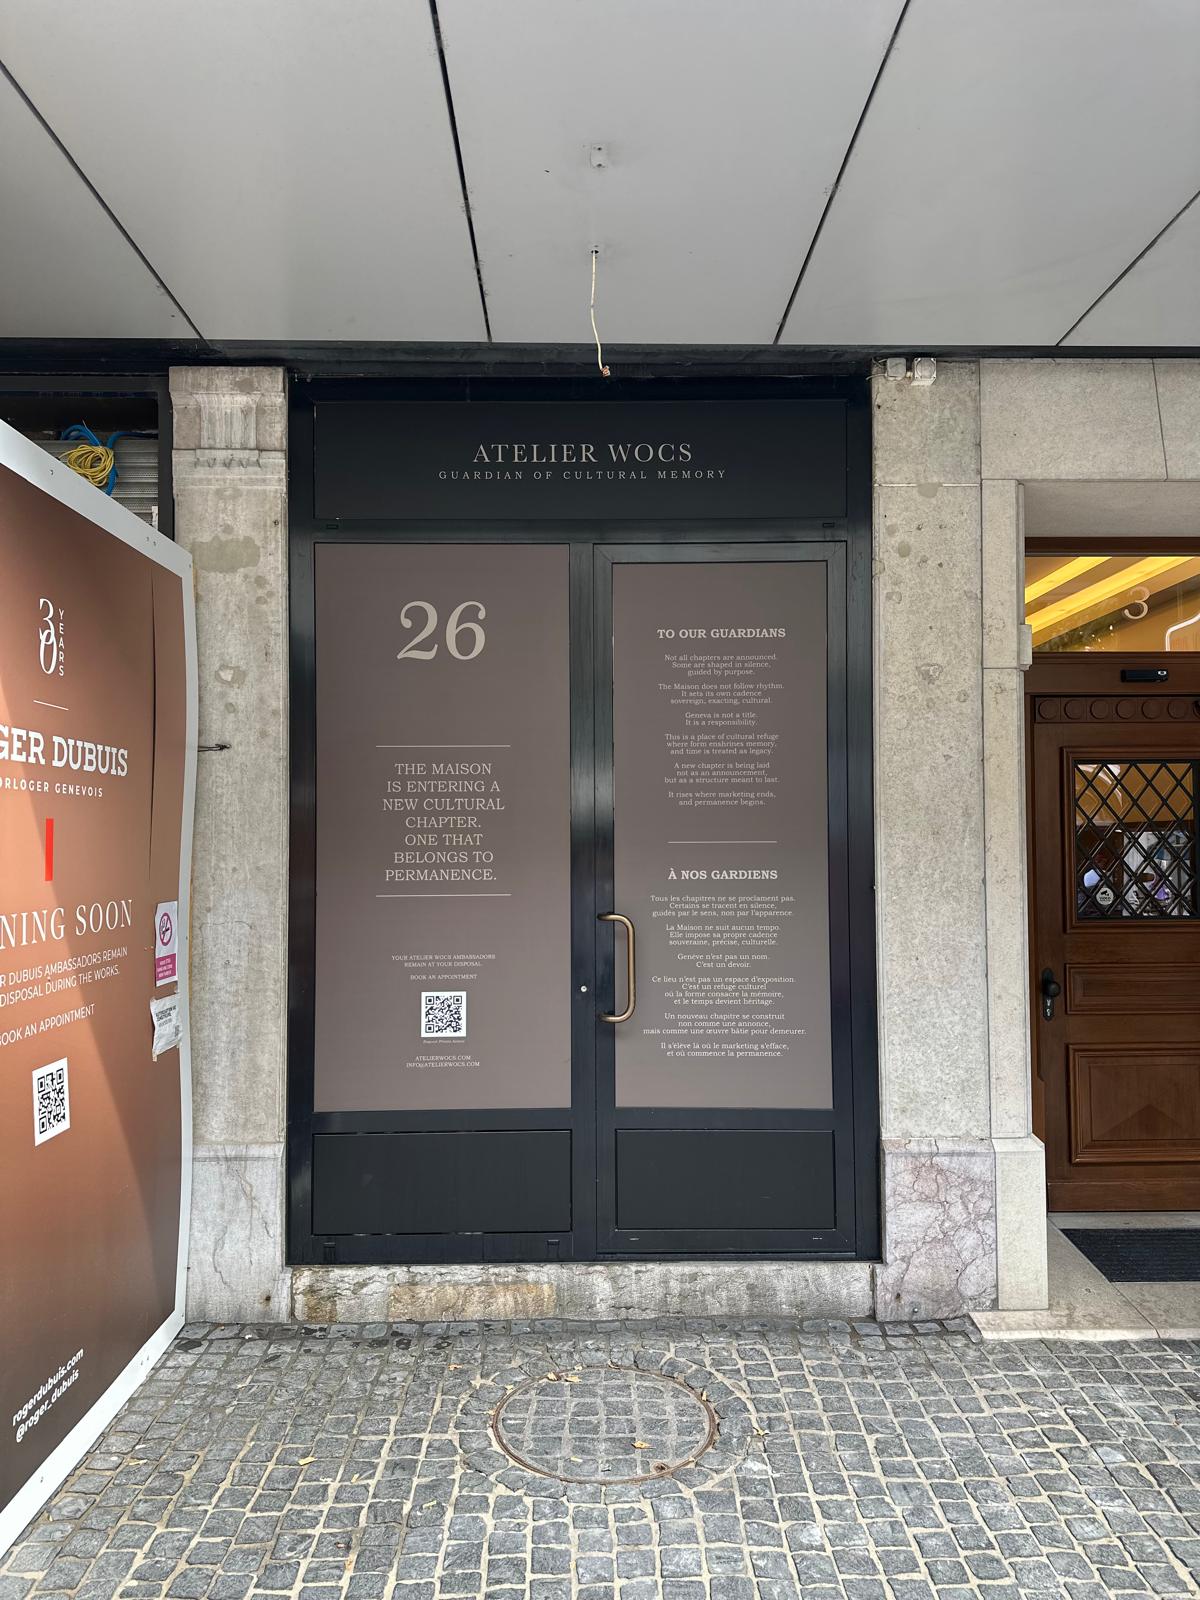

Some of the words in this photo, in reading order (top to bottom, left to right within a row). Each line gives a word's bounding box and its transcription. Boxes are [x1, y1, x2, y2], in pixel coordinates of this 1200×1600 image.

[474, 444, 598, 462] ATELIER
[608, 443, 692, 462] WOCS
[438, 471, 524, 479] GUARDIAN
[534, 471, 552, 479] OF
[563, 470, 646, 479] CULTURAL
[657, 470, 724, 478] MEMORY
[1124, 586, 1150, 620] 3
[397, 600, 486, 660] 26
[656, 629, 675, 638] TO
[678, 628, 706, 638] OUR
[710, 628, 786, 638] GUARDIANS
[690, 654, 720, 662] chapters
[707, 661, 732, 669] shaped
[687, 668, 711, 677] guided
[713, 668, 722, 677] by
[697, 733, 715, 742] place
[757, 733, 778, 741] refuge
[52, 735, 128, 777] DUBUIS
[394, 763, 426, 774] THE
[431, 763, 491, 774] MAISON
[55, 783, 102, 798] GENEVOIS
[387, 780, 401, 792] IS
[407, 780, 485, 792] ENTERING
[490, 780, 500, 791] A
[718, 791, 755, 799] marketing
[383, 798, 418, 810] NEW
[423, 798, 504, 810] CULTURAL
[405, 816, 482, 827] CHAPTER.
[404, 834, 437, 845] ONE
[442, 833, 483, 845] THAT
[394, 851, 468, 863] BELONGS
[472, 851, 493, 862] TO
[386, 868, 497, 880] PERMANENCE.
[668, 867, 677, 879] À
[680, 870, 707, 879] NOS
[710, 870, 778, 879] GARDIENS
[76, 900, 132, 936] SOON
[8, 966, 42, 986] DUBUIS
[44, 952, 101, 976] AMBASSADORS
[102, 946, 128, 962] REMAIN
[46, 976, 76, 995] DURING
[78, 971, 92, 985] THE
[94, 964, 120, 980] WORKS.
[714, 983, 736, 991] refuge
[710, 1013, 740, 1021] chapitre
[0, 1028, 22, 1046] OOK
[24, 1022, 37, 1038] AN
[39, 1004, 95, 1032] APPOINTMENT
[12, 1348, 84, 1426] rogerdubuis.com
[16, 1369, 79, 1443] @roger_dubuis
